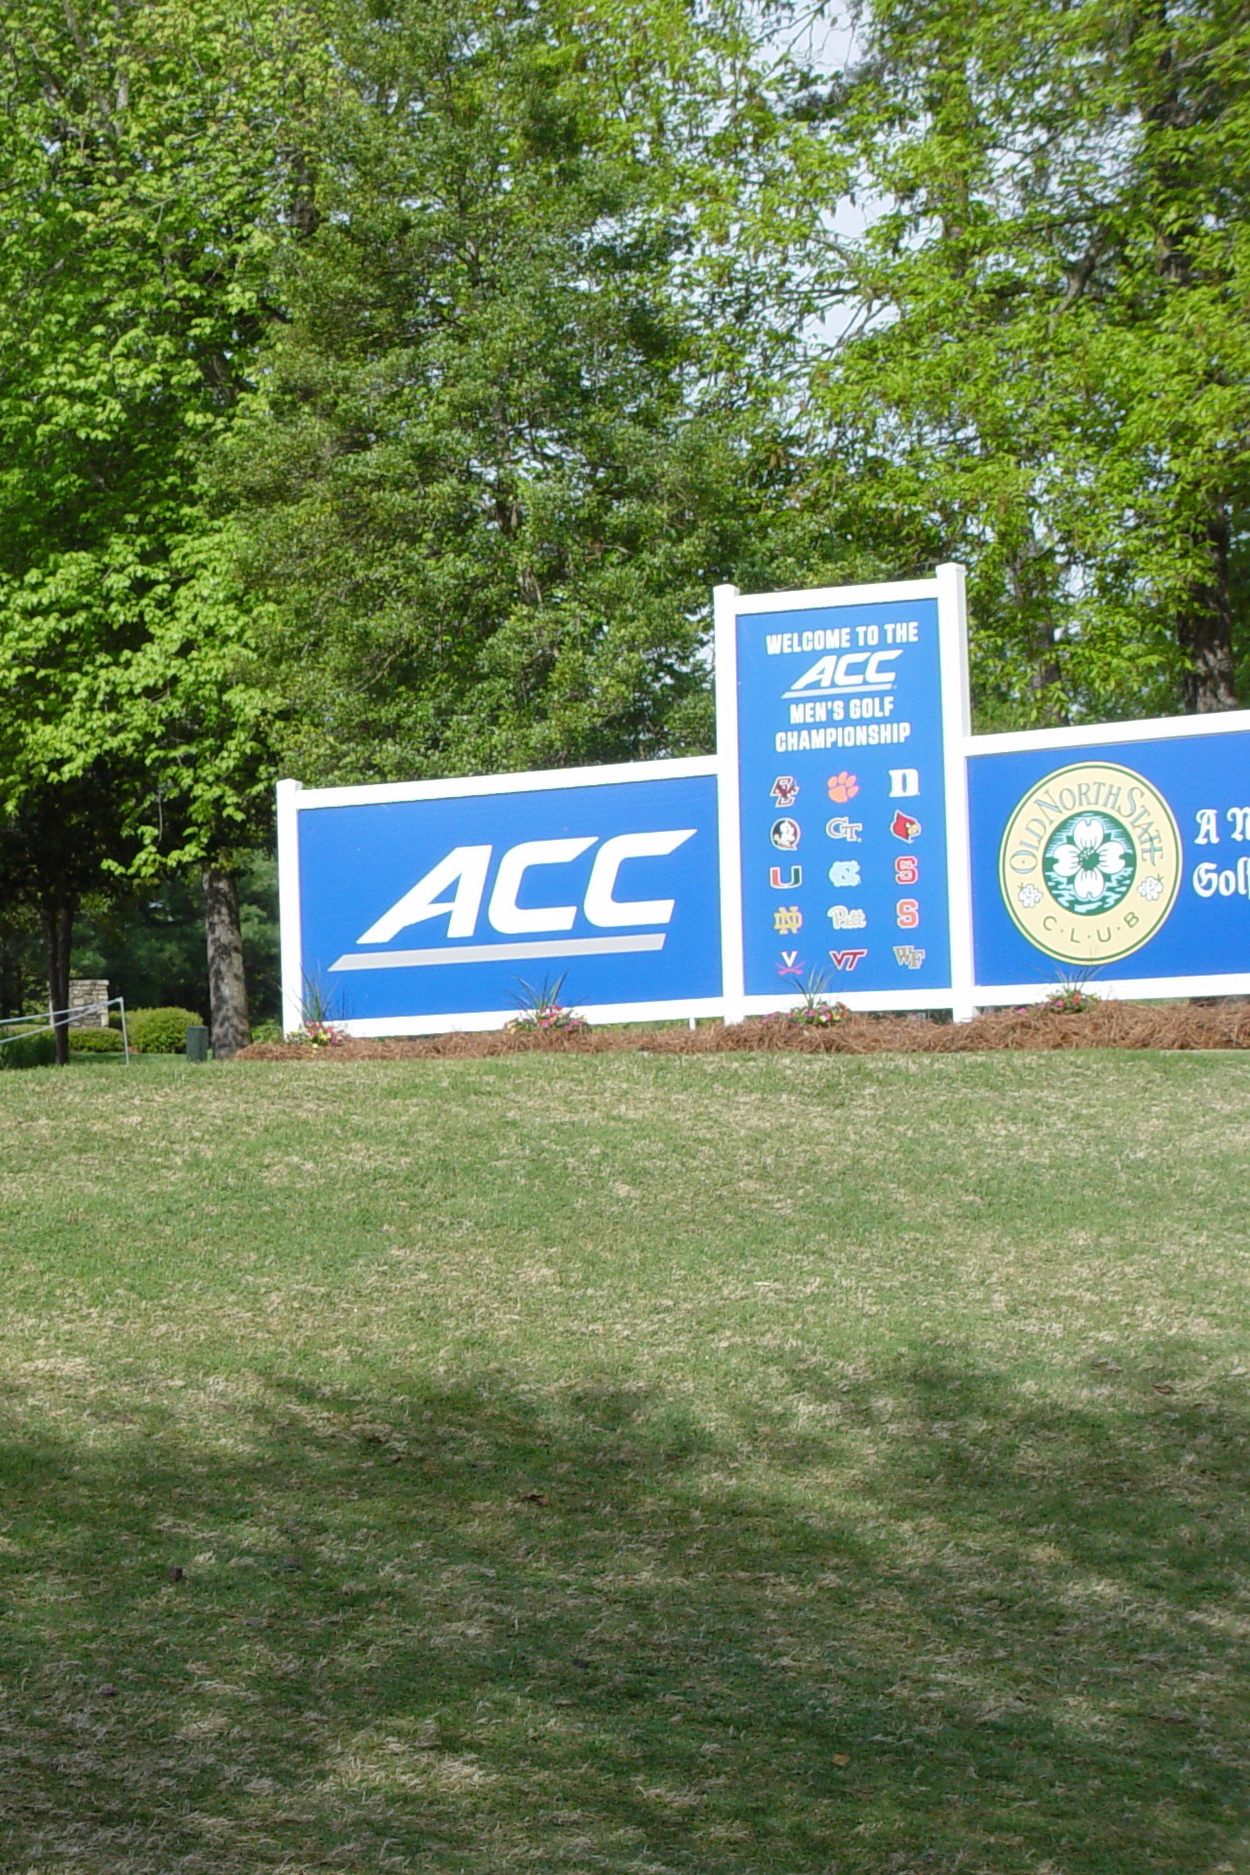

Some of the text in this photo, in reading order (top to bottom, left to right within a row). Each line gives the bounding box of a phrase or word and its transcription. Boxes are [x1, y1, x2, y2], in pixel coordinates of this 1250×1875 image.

[766, 622, 919, 655] WELCOME TO THE
[790, 649, 903, 690] ACC
[790, 696, 894, 724] MEN'S GOLF
[775, 722, 911, 752] CHAMPIONSHIP
[1009, 817, 1047, 874] OLD
[1035, 781, 1122, 826] NORTH
[1117, 786, 1165, 867] STATE
[1194, 808, 1220, 845] A
[356, 829, 698, 945] ACC
[896, 898, 919, 929] S
